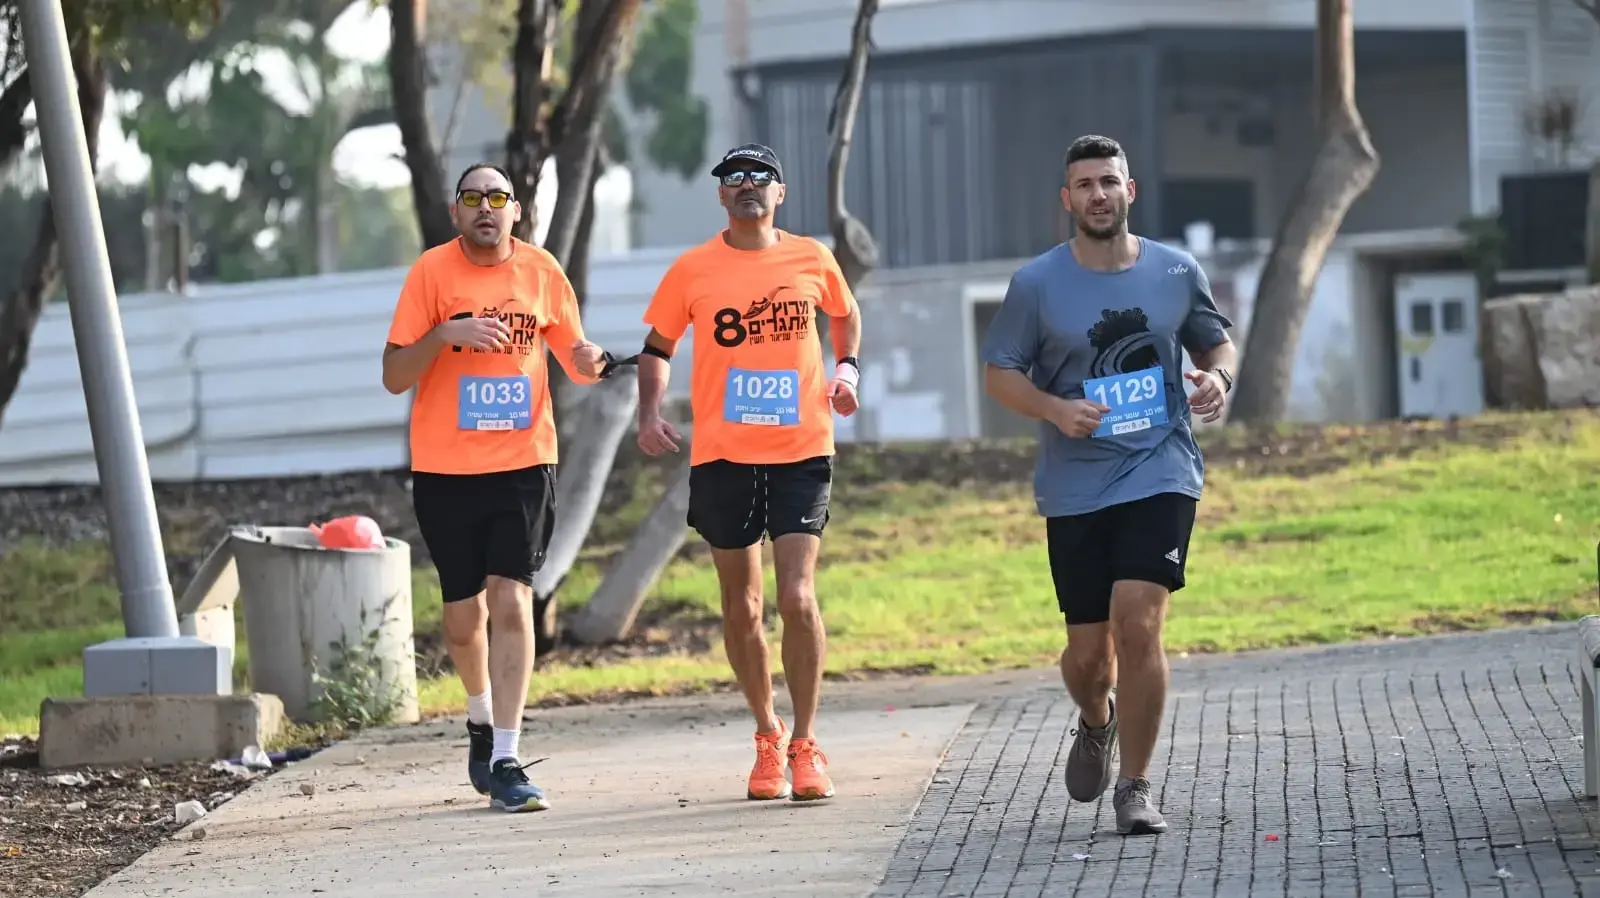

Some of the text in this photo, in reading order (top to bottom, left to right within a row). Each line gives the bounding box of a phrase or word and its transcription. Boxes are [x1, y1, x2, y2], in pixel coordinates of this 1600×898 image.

[772, 300, 808, 322] מרוץ
[713, 307, 748, 348] 8
[466, 381, 526, 405] 1033
[732, 374, 793, 399] 1028
[1094, 375, 1157, 406] 1129
